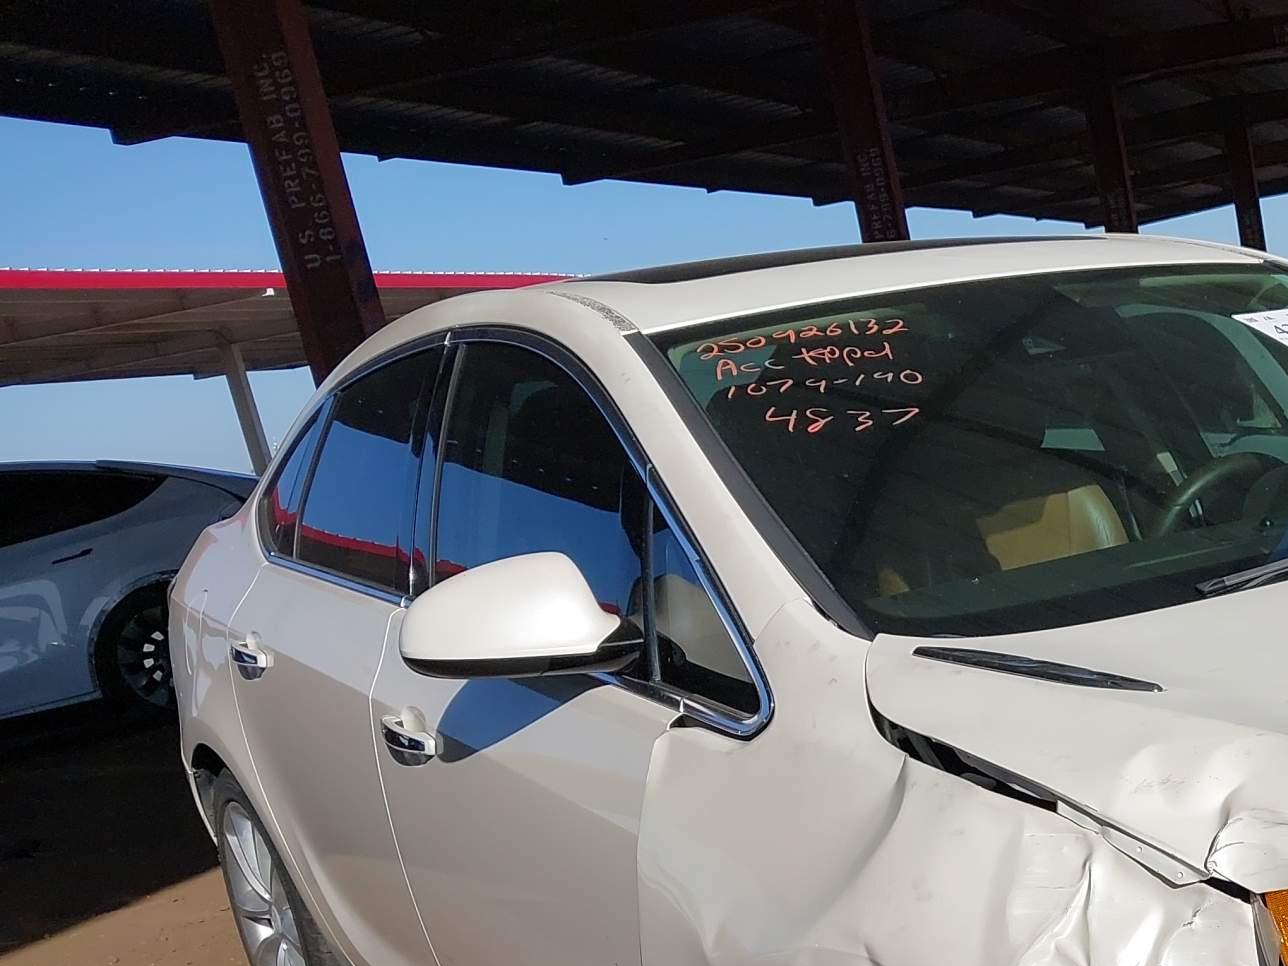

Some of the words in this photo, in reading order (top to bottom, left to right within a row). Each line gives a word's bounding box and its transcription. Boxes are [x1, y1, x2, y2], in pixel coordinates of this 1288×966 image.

[267, 113, 307, 209] PREFAB
[696, 318, 909, 361] 250926132
[764, 406, 921, 434] 4837
